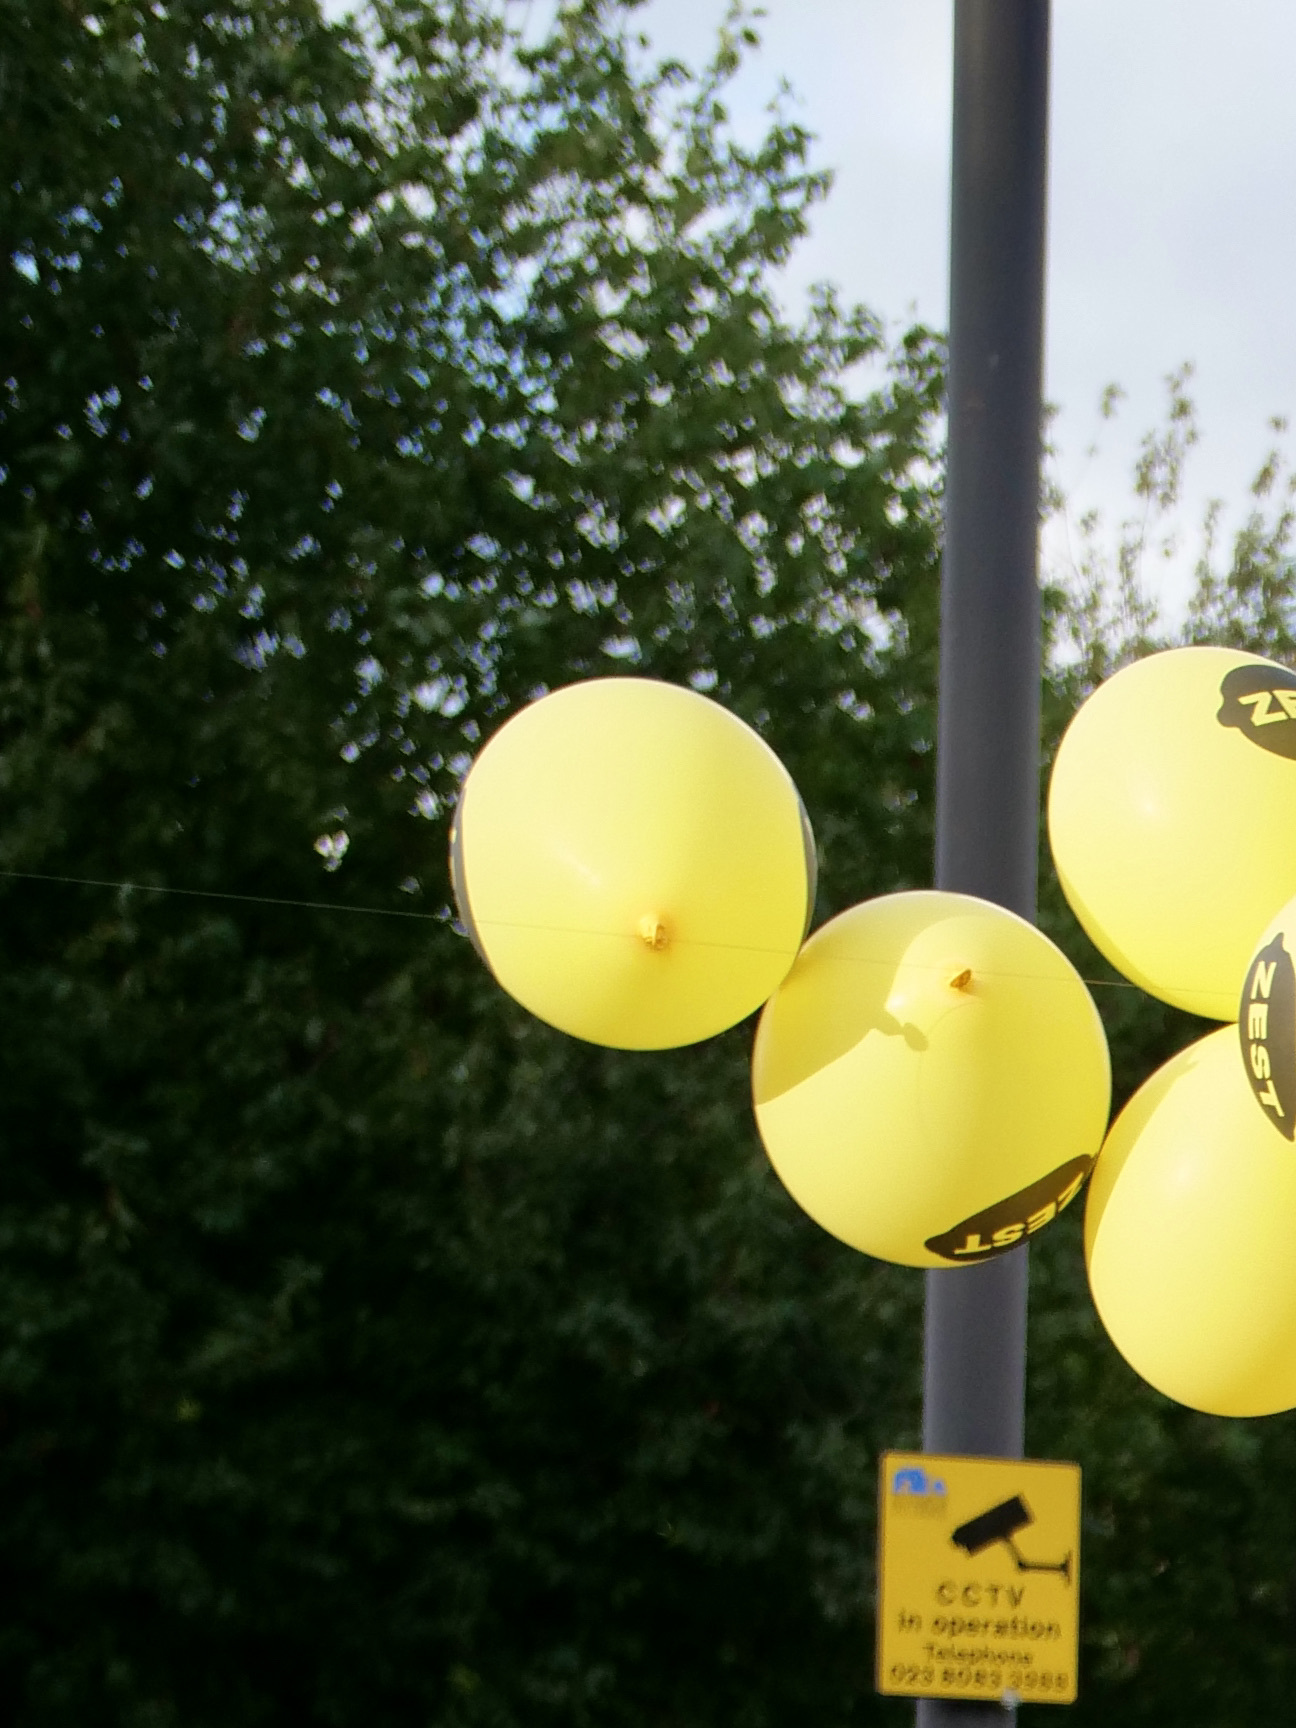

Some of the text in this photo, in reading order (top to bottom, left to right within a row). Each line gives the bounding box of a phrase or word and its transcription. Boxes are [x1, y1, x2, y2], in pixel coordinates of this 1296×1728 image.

[1248, 961, 1285, 1117] ZEST
[937, 1580, 1025, 1608] CCTV
[931, 1614, 1062, 1640] operation
[924, 1642, 1033, 1665] Telephone
